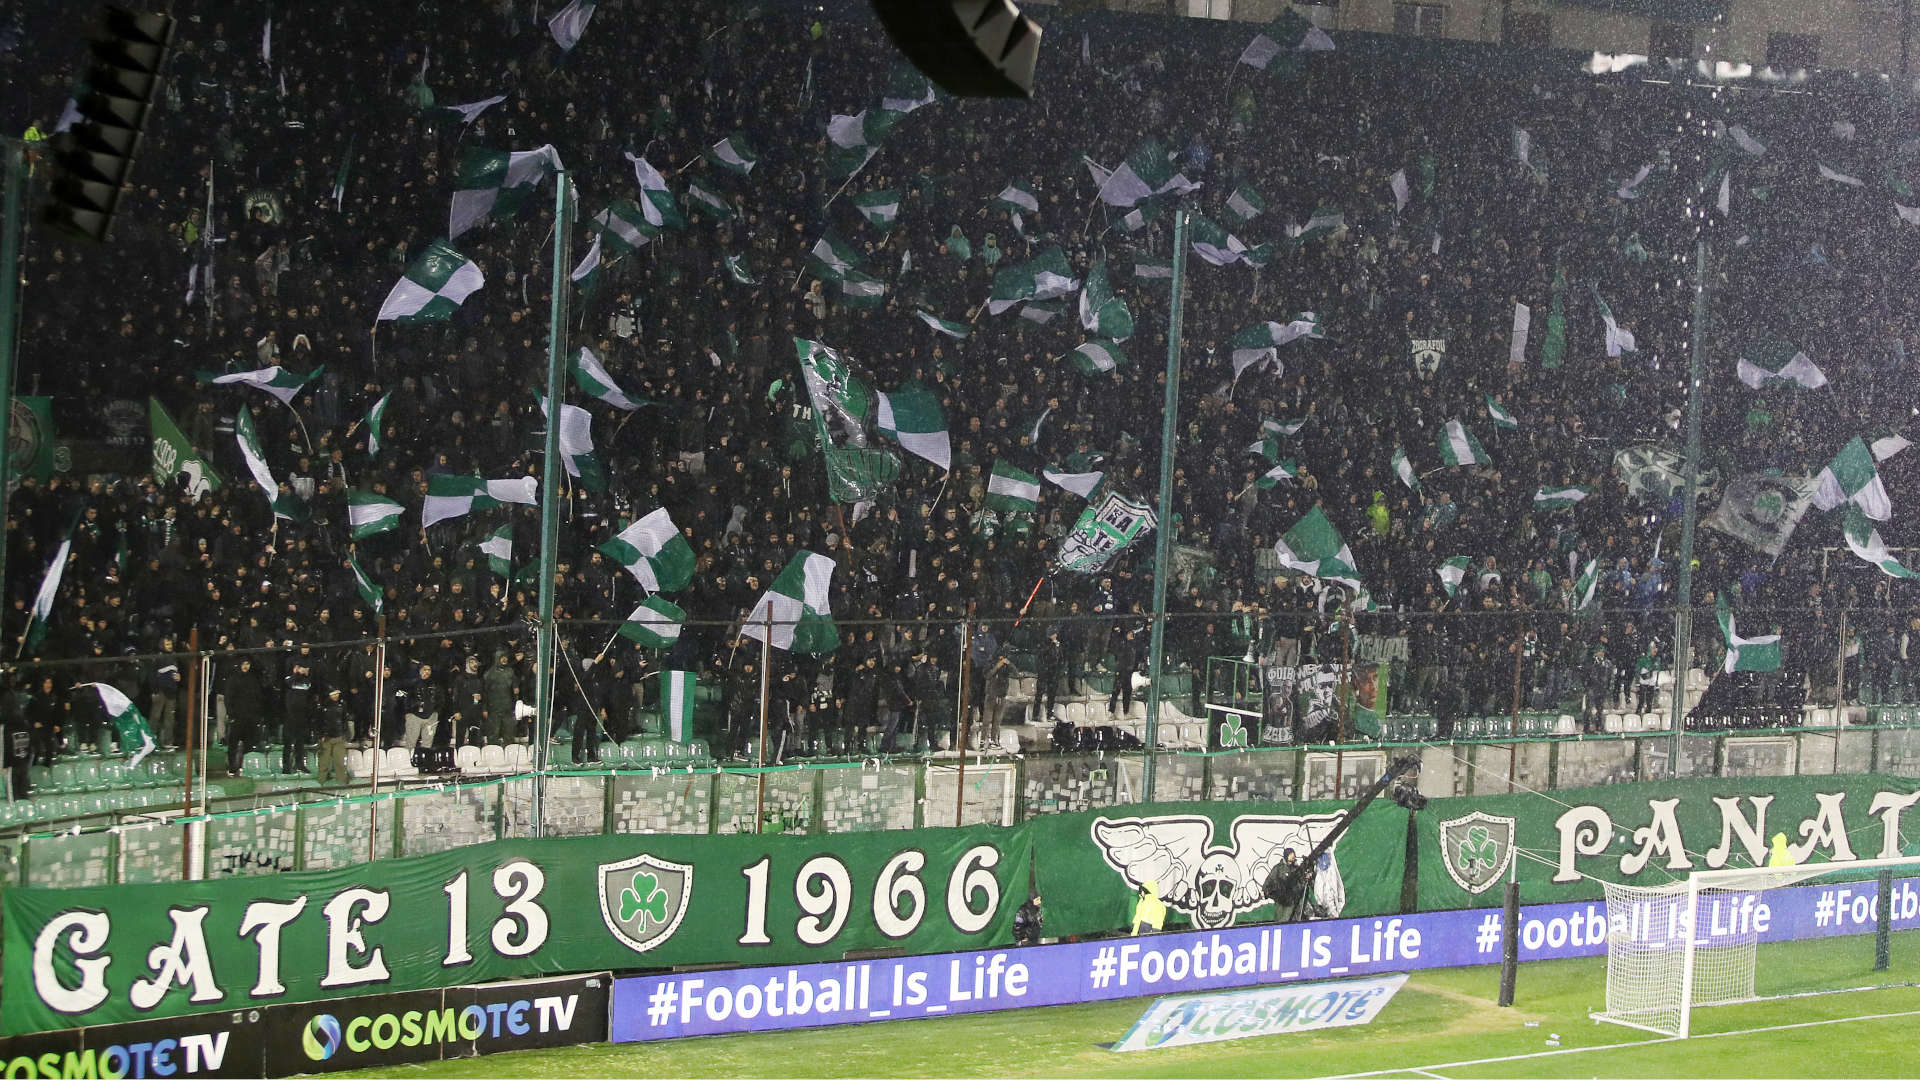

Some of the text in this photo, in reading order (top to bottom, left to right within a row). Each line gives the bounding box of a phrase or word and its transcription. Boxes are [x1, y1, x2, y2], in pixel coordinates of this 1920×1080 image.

[33, 845, 1000, 1014] GATE 13 1966
[1090, 919, 1421, 989] #Football_Is_Life
[345, 994, 579, 1053] COSMOTE TV
[647, 952, 1030, 1026] #Football_Is_Life
[0, 1032, 230, 1080] OSMOTE TV
